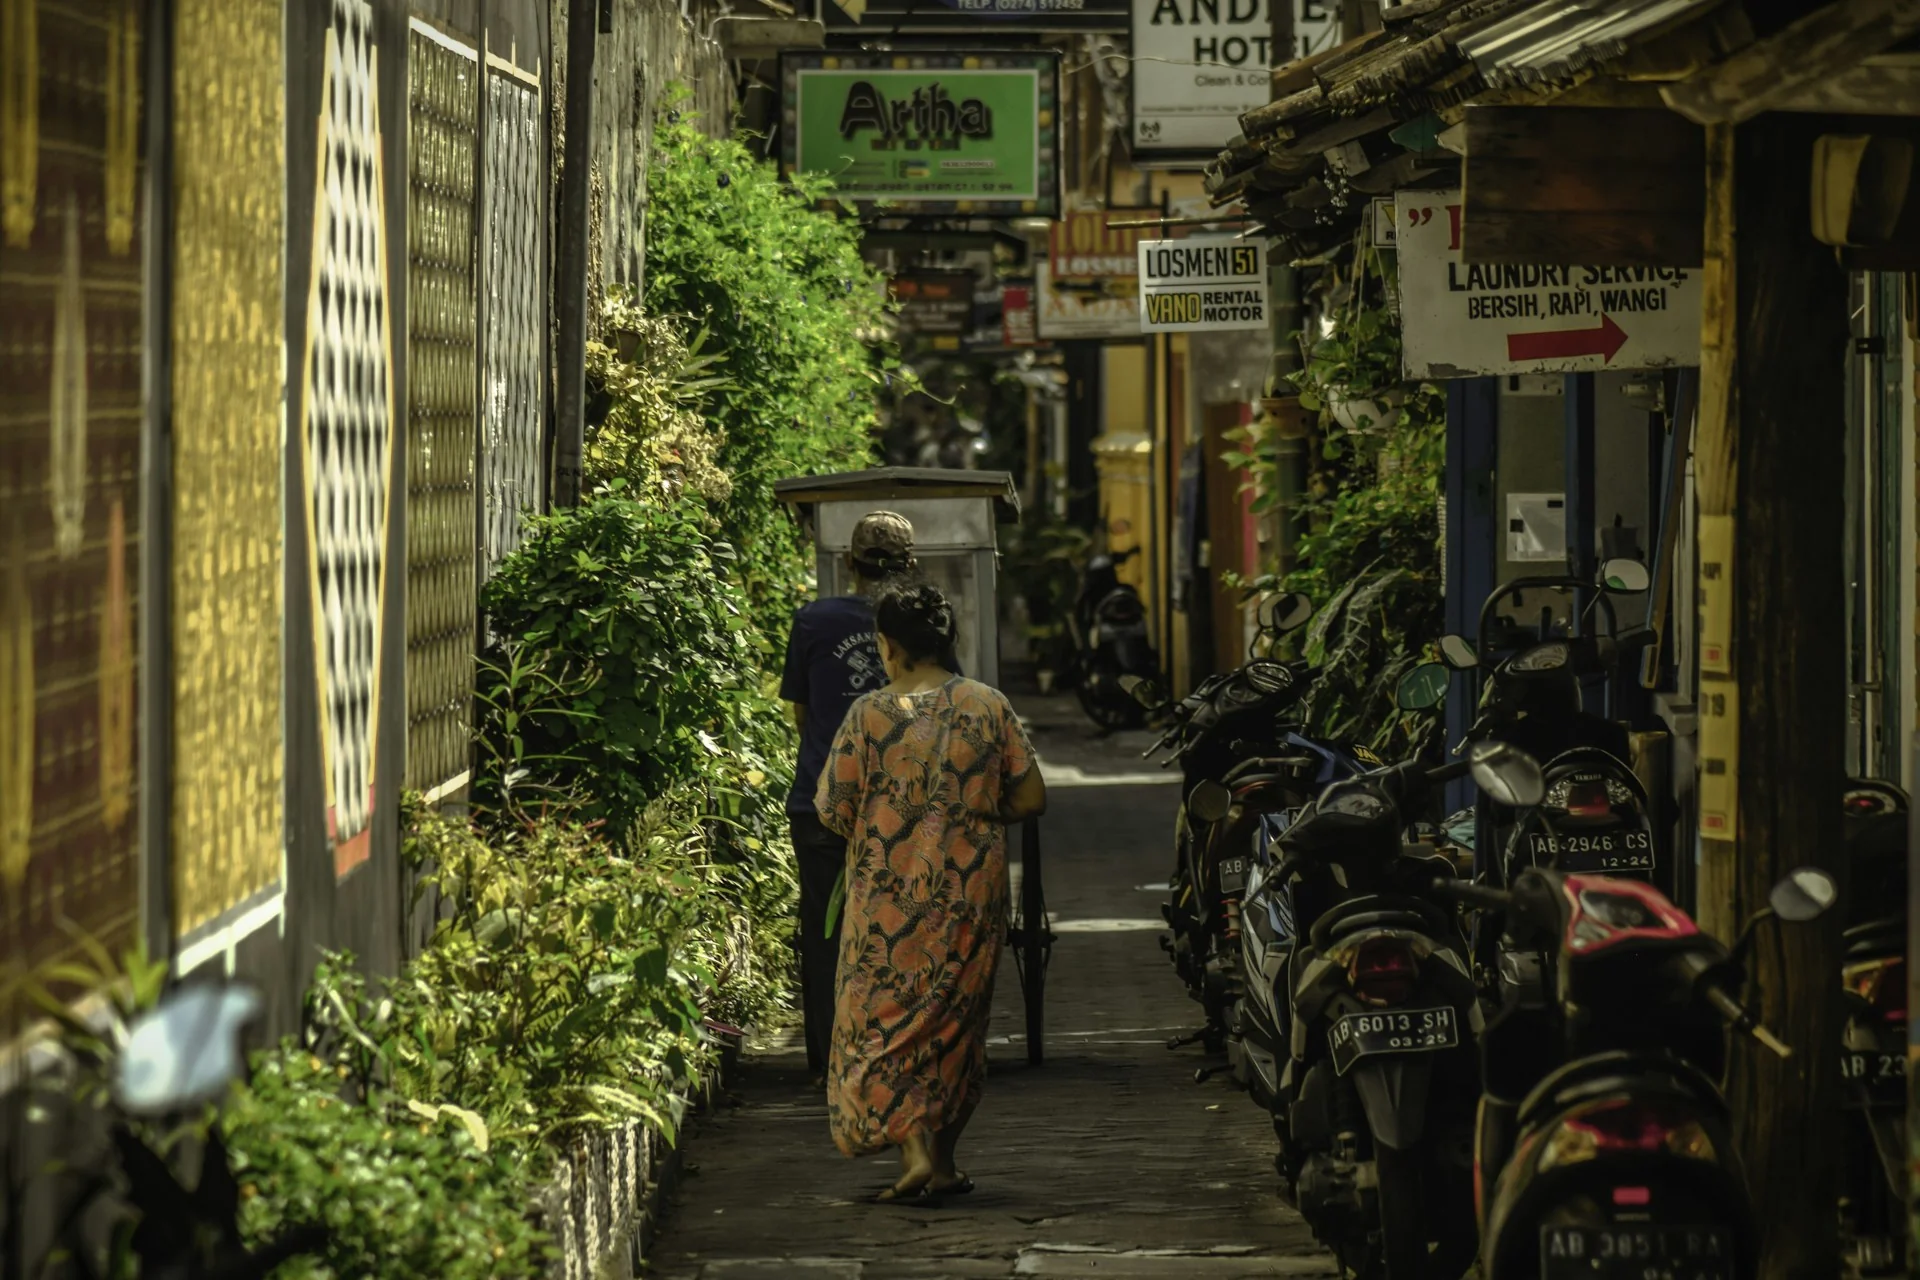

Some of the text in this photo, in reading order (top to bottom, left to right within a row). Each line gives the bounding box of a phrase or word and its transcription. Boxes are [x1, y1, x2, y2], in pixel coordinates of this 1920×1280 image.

[957, 0, 992, 10] TELP.
[1151, 0, 1326, 25] ANDE
[1194, 37, 1309, 65] HOTL
[1195, 74, 1231, 86] Clean
[1235, 74, 1243, 86] &
[838, 81, 992, 140] Artha
[1147, 247, 1255, 278] LOSMEN 51
[1449, 263, 1570, 291] LAUNDRY
[1146, 292, 1201, 324] VANO
[1203, 291, 1262, 305] RENTAL
[1469, 288, 1666, 320] BERSIH, RAPI, WANGI
[1203, 306, 1262, 321] MOTOR
[1574, 773, 1602, 781] YAMAHA
[1537, 833, 1648, 853] AB 2946 CS
[1225, 859, 1242, 875] AB
[1333, 1010, 1449, 1050] AB 6013 SH
